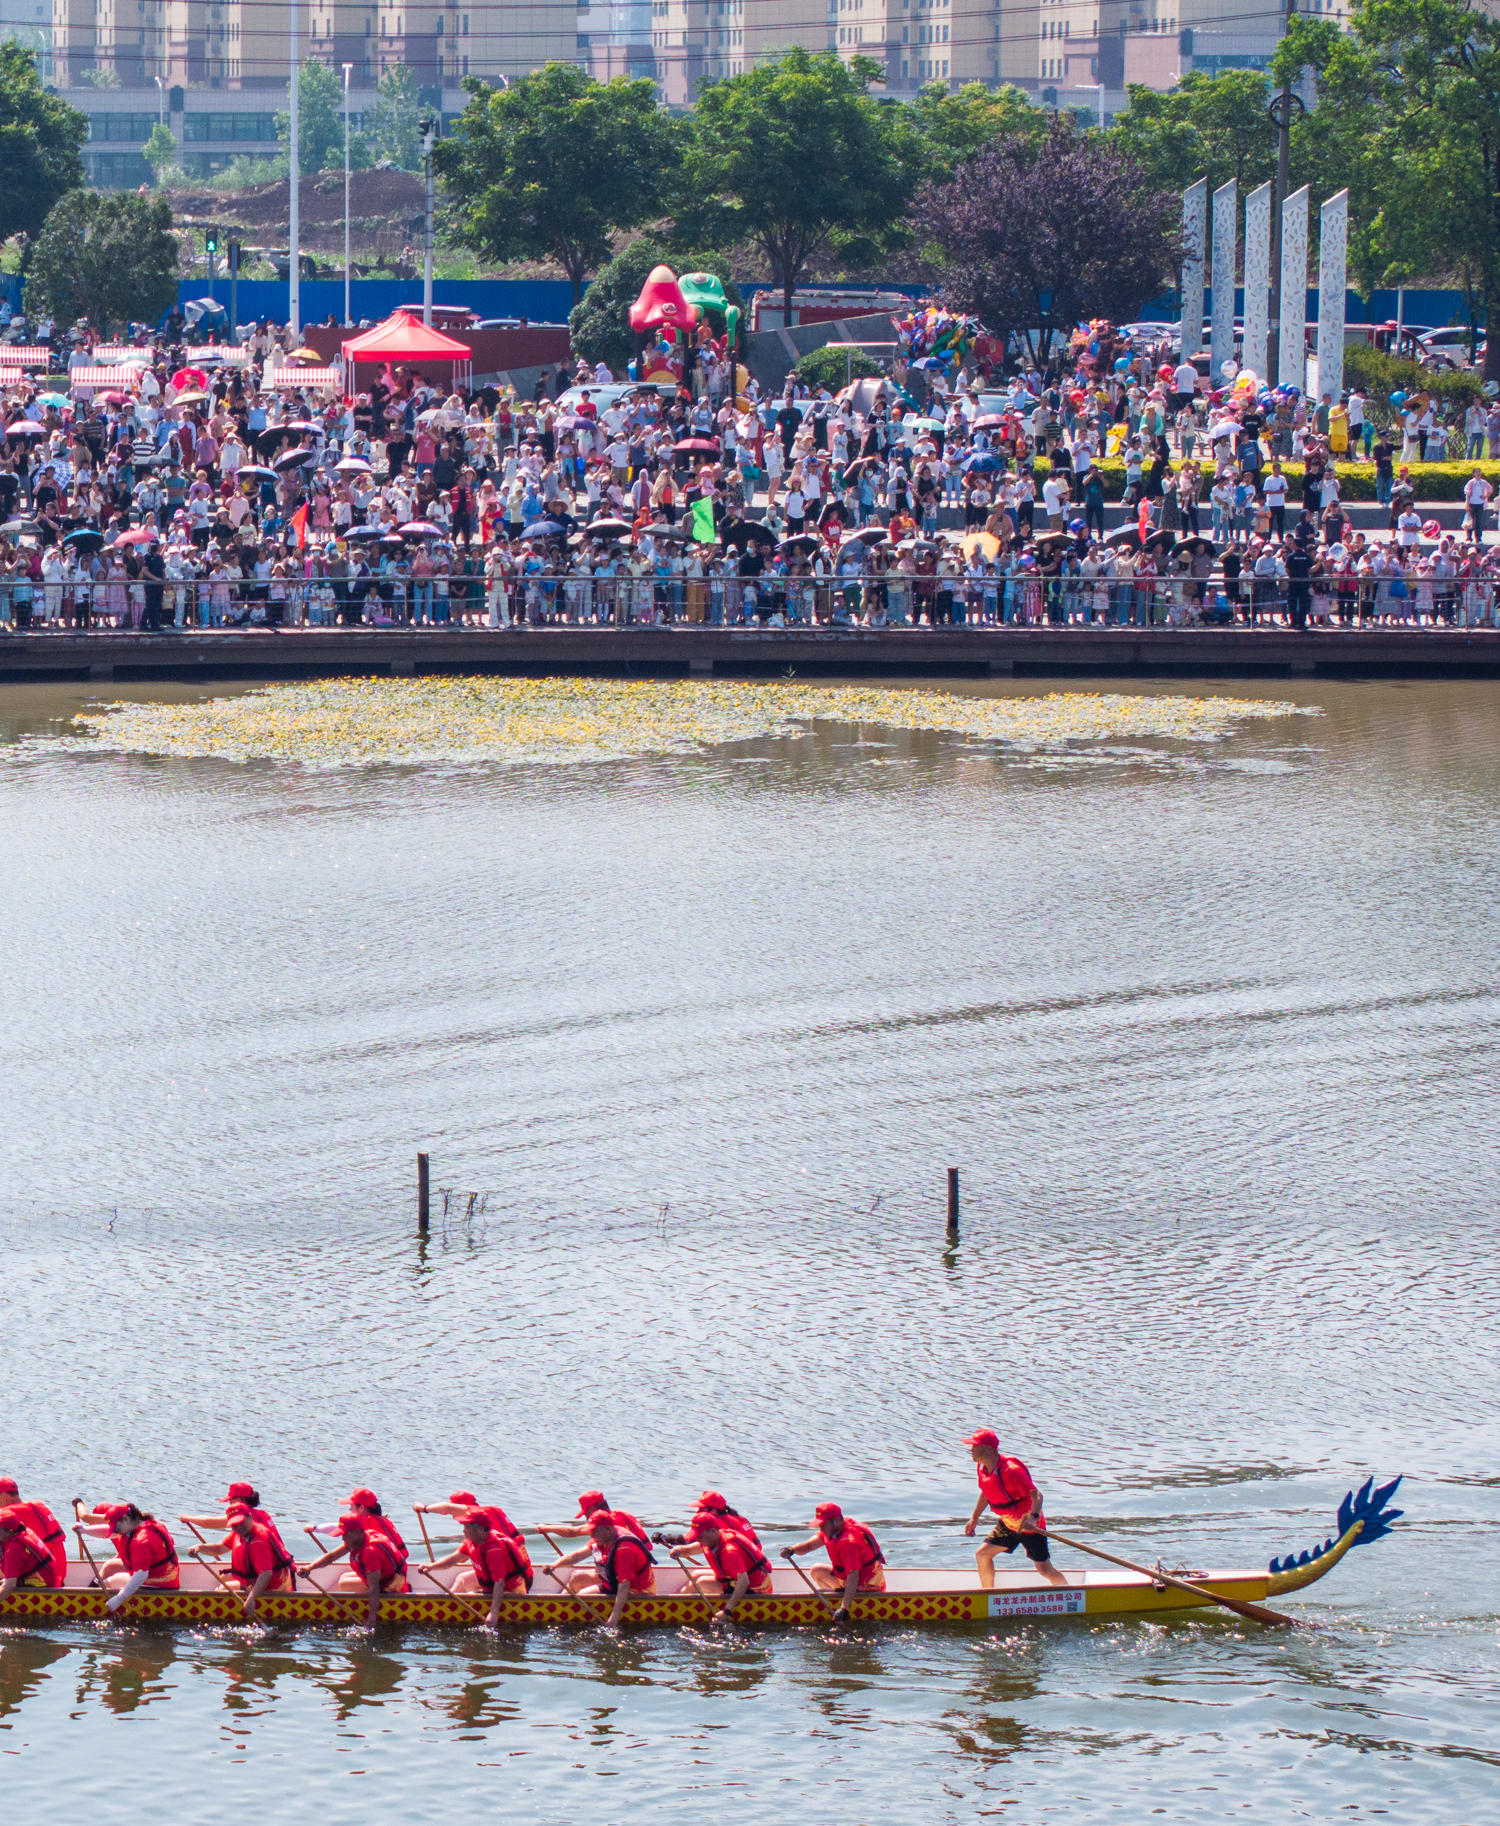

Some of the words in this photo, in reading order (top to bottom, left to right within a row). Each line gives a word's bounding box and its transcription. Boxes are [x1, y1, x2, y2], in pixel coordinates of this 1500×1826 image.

[993, 1593, 1082, 1605] 海龙龙舟制造有限公司
[997, 1607, 1014, 1615] 133
[1015, 1606, 1039, 1614] 6580
[1041, 1604, 1063, 1613] 3588
